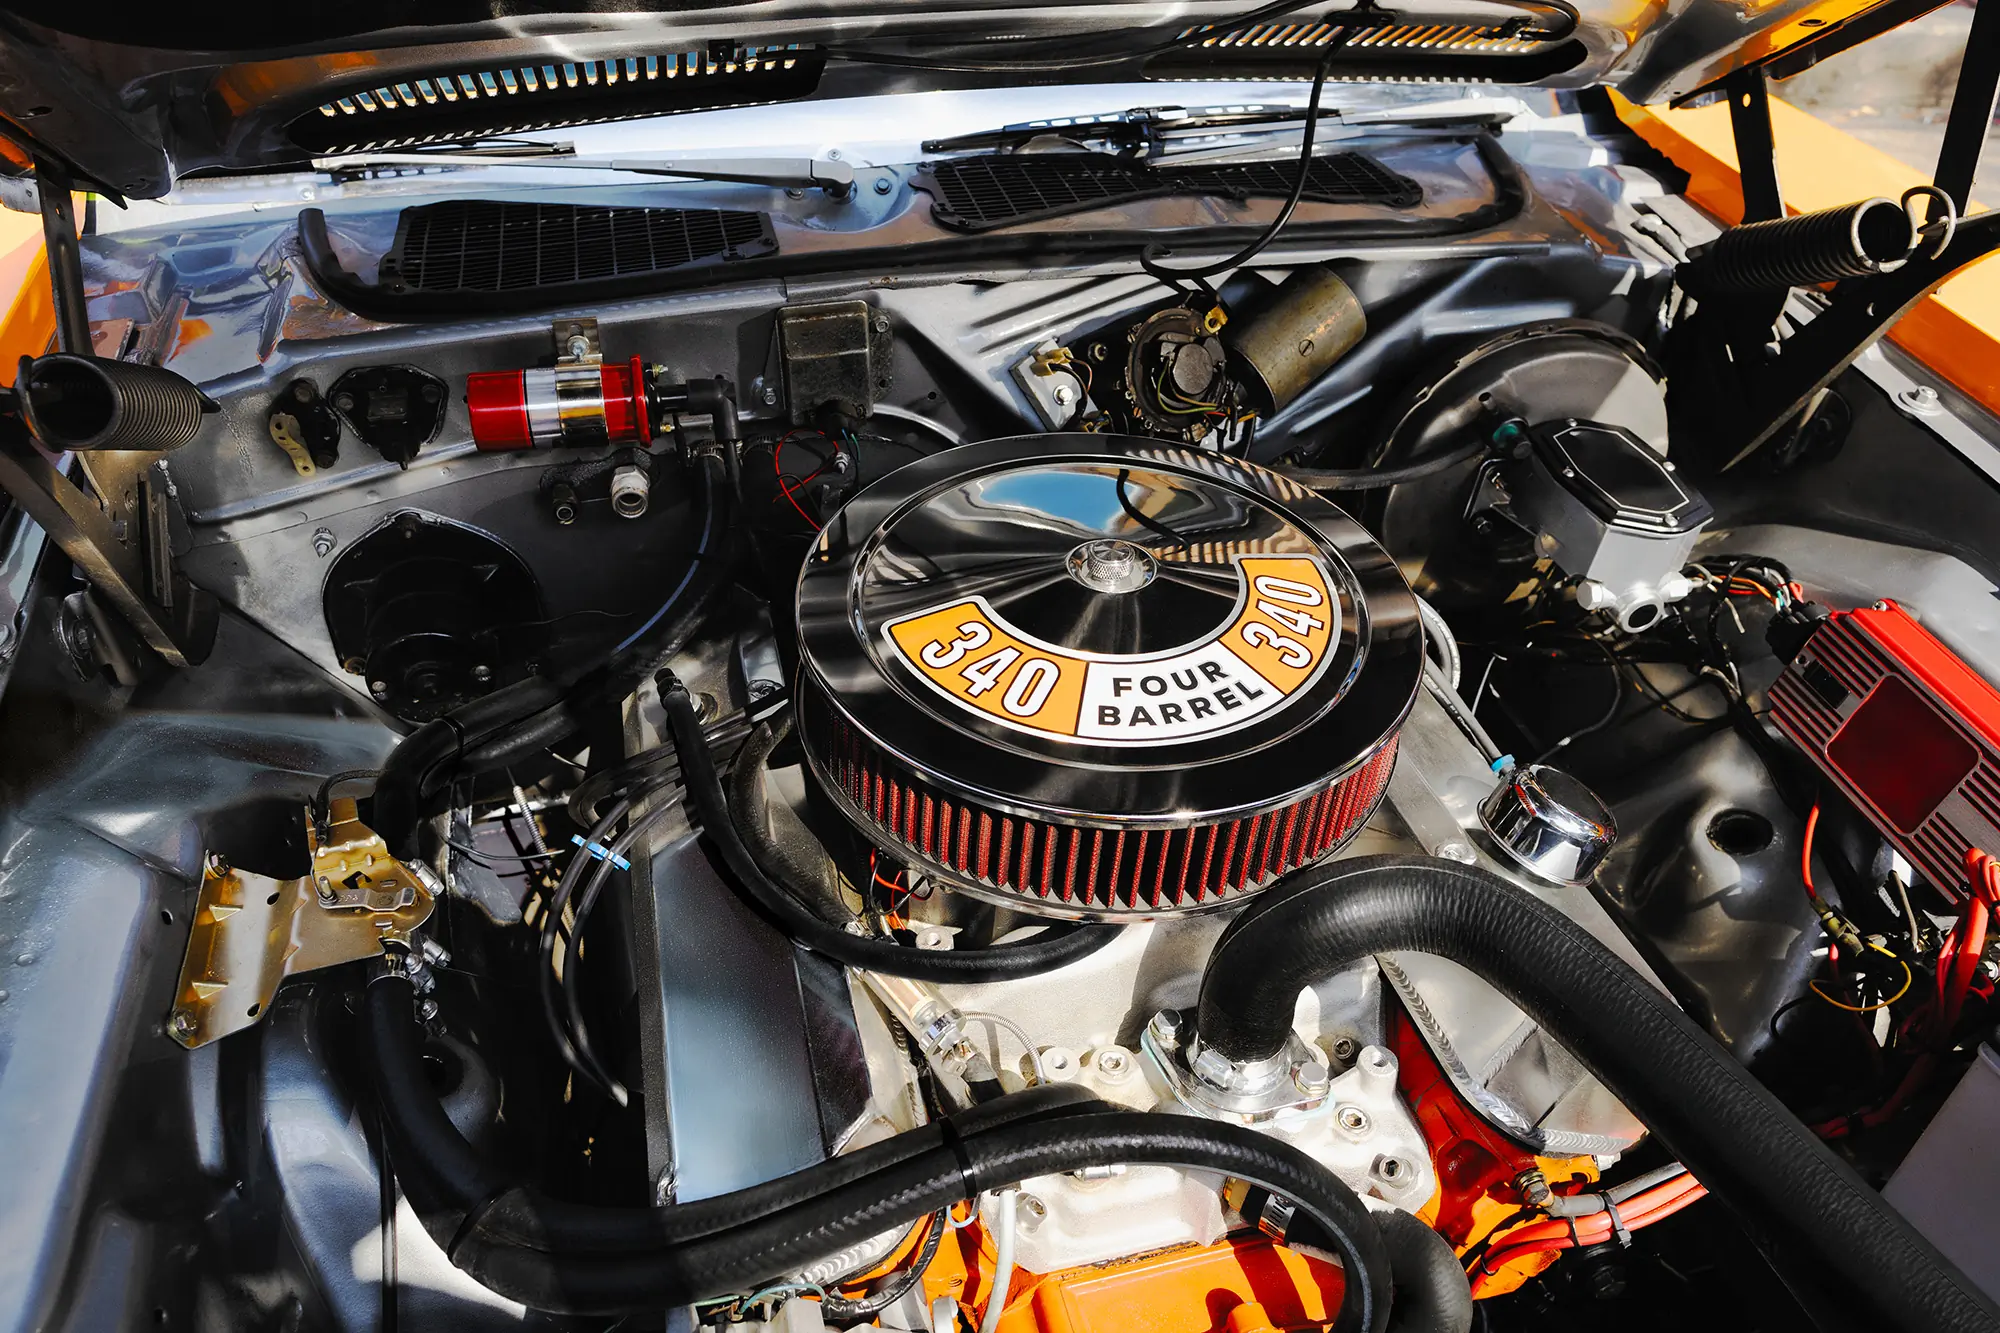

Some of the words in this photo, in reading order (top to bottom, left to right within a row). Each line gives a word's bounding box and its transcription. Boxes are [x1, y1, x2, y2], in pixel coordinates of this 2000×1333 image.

[1240, 575, 1324, 669] 340
[920, 621, 1061, 717] 340
[1098, 681, 1264, 726] BARREL
[1113, 661, 1229, 697] FOUR
